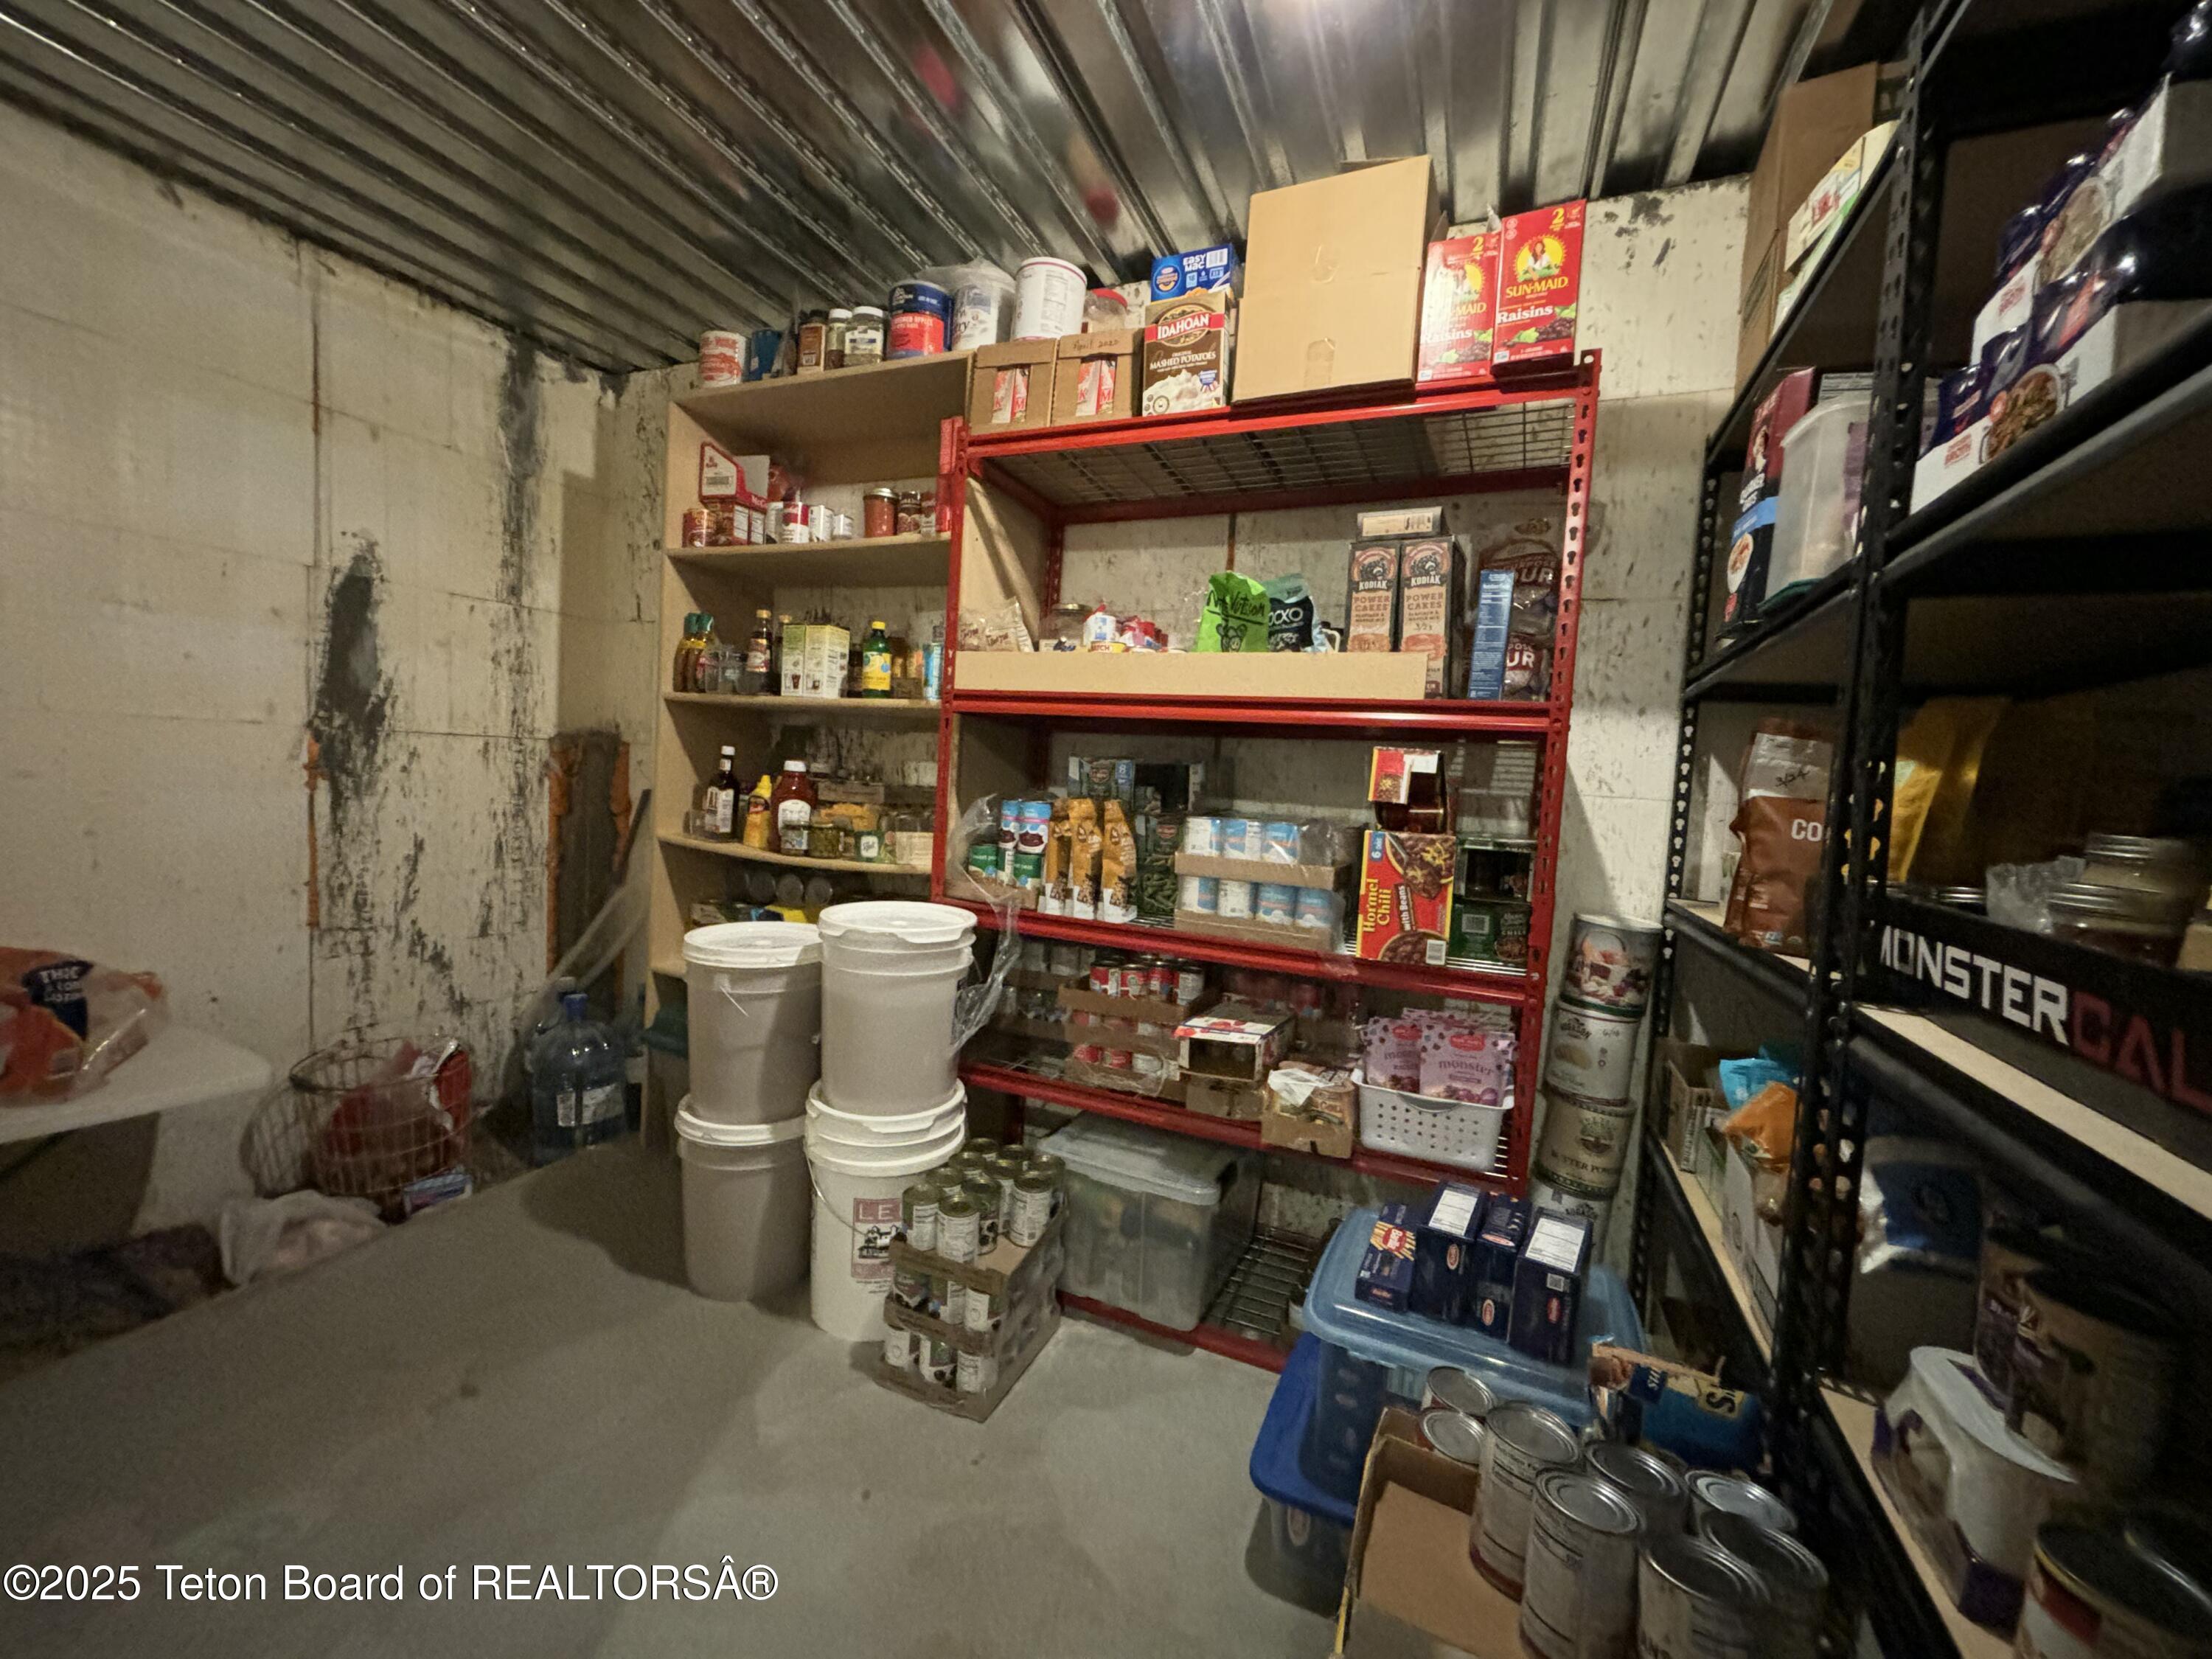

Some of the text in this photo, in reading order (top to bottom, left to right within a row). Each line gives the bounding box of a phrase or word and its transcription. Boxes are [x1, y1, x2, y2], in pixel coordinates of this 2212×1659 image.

[1551, 207, 1565, 226] 2
[1472, 236, 1484, 253] 2
[1506, 276, 1569, 299] SUN-MAID
[1498, 305, 1554, 325] Raisins
[1157, 313, 1210, 340] IDAHOAN
[1150, 356, 1180, 369] MASHED
[1180, 351, 1217, 364] POTATOES
[1359, 580, 1388, 591] KODIAK
[1411, 575, 1441, 587] KODIAK
[1353, 595, 1391, 604] POWER
[1405, 592, 1444, 602] POWER
[1408, 601, 1442, 611] CAKES
[1354, 604, 1388, 612] CAKES
[1791, 818, 1826, 844] CO
[1362, 878, 1380, 933] Hormel
[1377, 888, 1392, 926] Chili
[1398, 886, 1411, 931] with Beans
